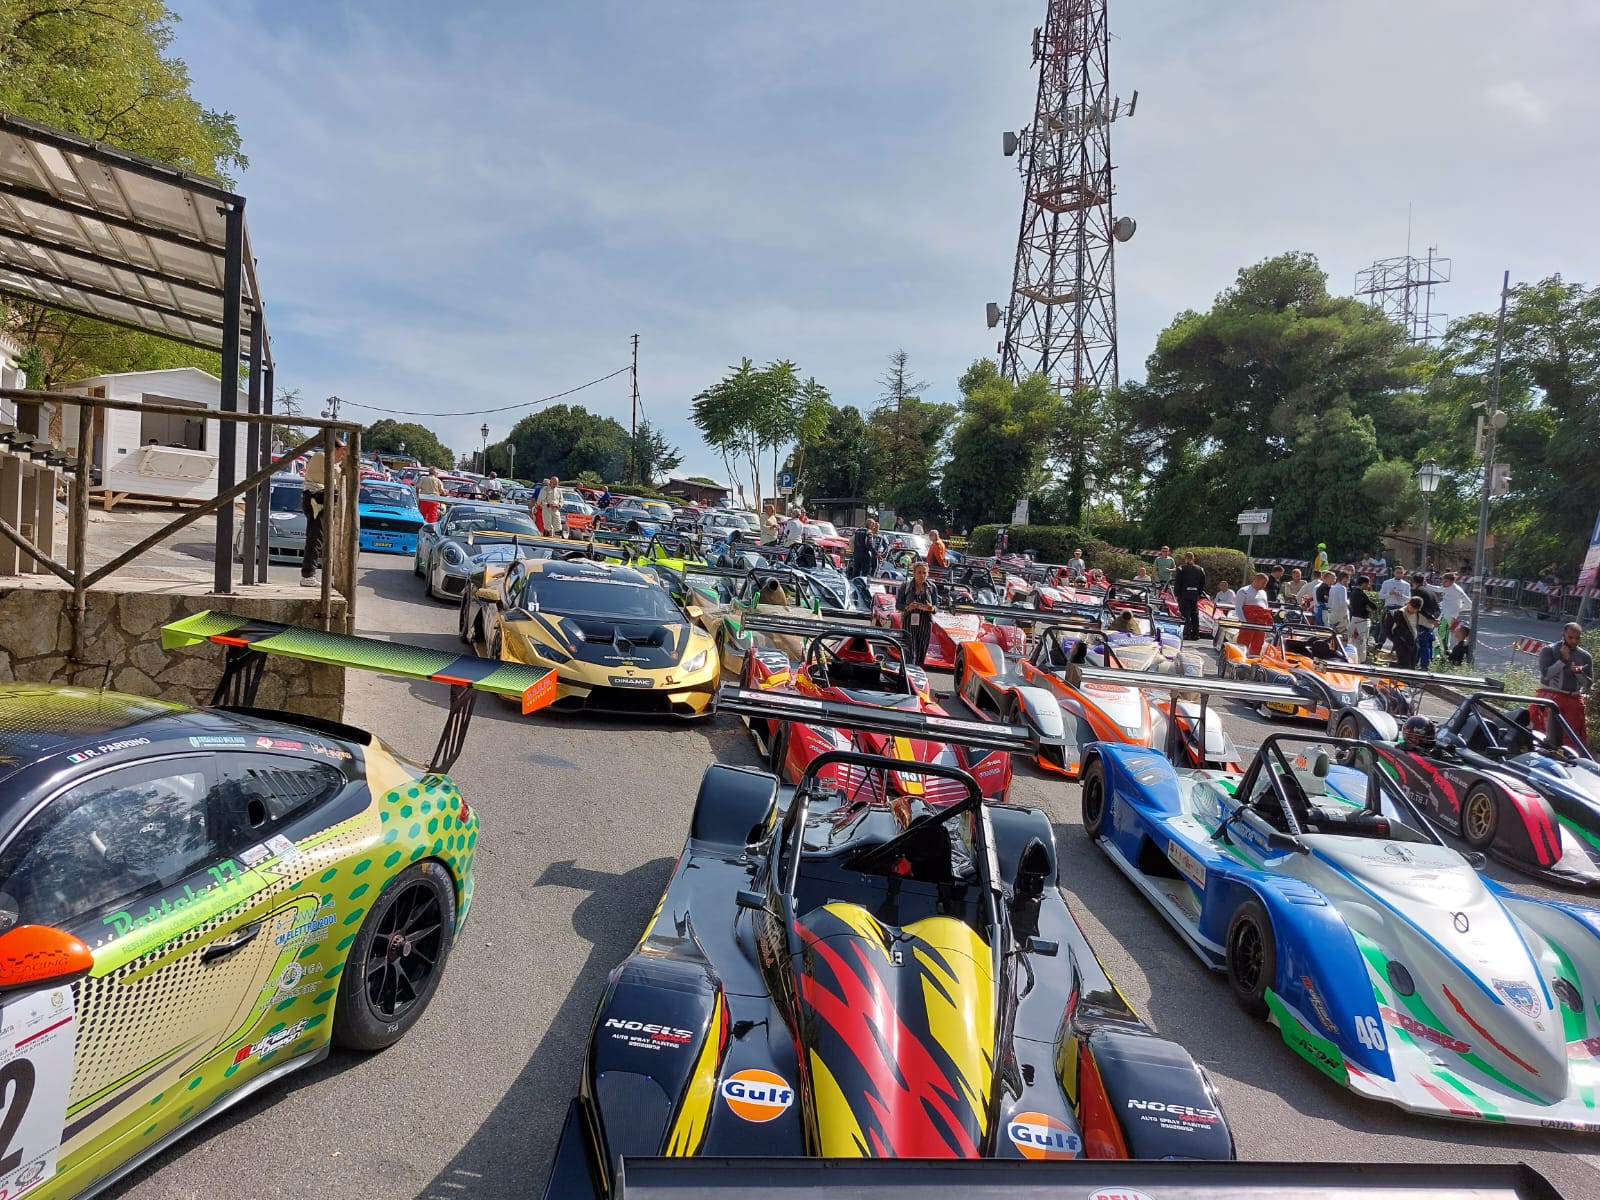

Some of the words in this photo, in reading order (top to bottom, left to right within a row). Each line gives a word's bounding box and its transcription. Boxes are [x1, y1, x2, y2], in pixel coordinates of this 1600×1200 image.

[782, 474, 791, 487] P
[528, 602, 539, 612] 61
[614, 678, 651, 686] DINAMIC
[84, 749, 102, 758] R.
[98, 737, 151, 754] PARRINO
[275, 934, 286, 946] CM
[286, 919, 320, 941] ELETTRO
[319, 914, 337, 930] 2001
[605, 1018, 693, 1039] NOEL'S
[1354, 1015, 1386, 1051] 46
[611, 1033, 629, 1041] AUTO
[630, 1036, 651, 1044] SPRAY
[652, 1039, 680, 1049] PAINTING
[725, 1081, 792, 1104] Gulf
[1128, 1099, 1217, 1119] NOEL'S
[1159, 1117, 1180, 1125] SPRAY
[1183, 1120, 1211, 1130] PAINTING
[1011, 1125, 1078, 1150] Gulf
